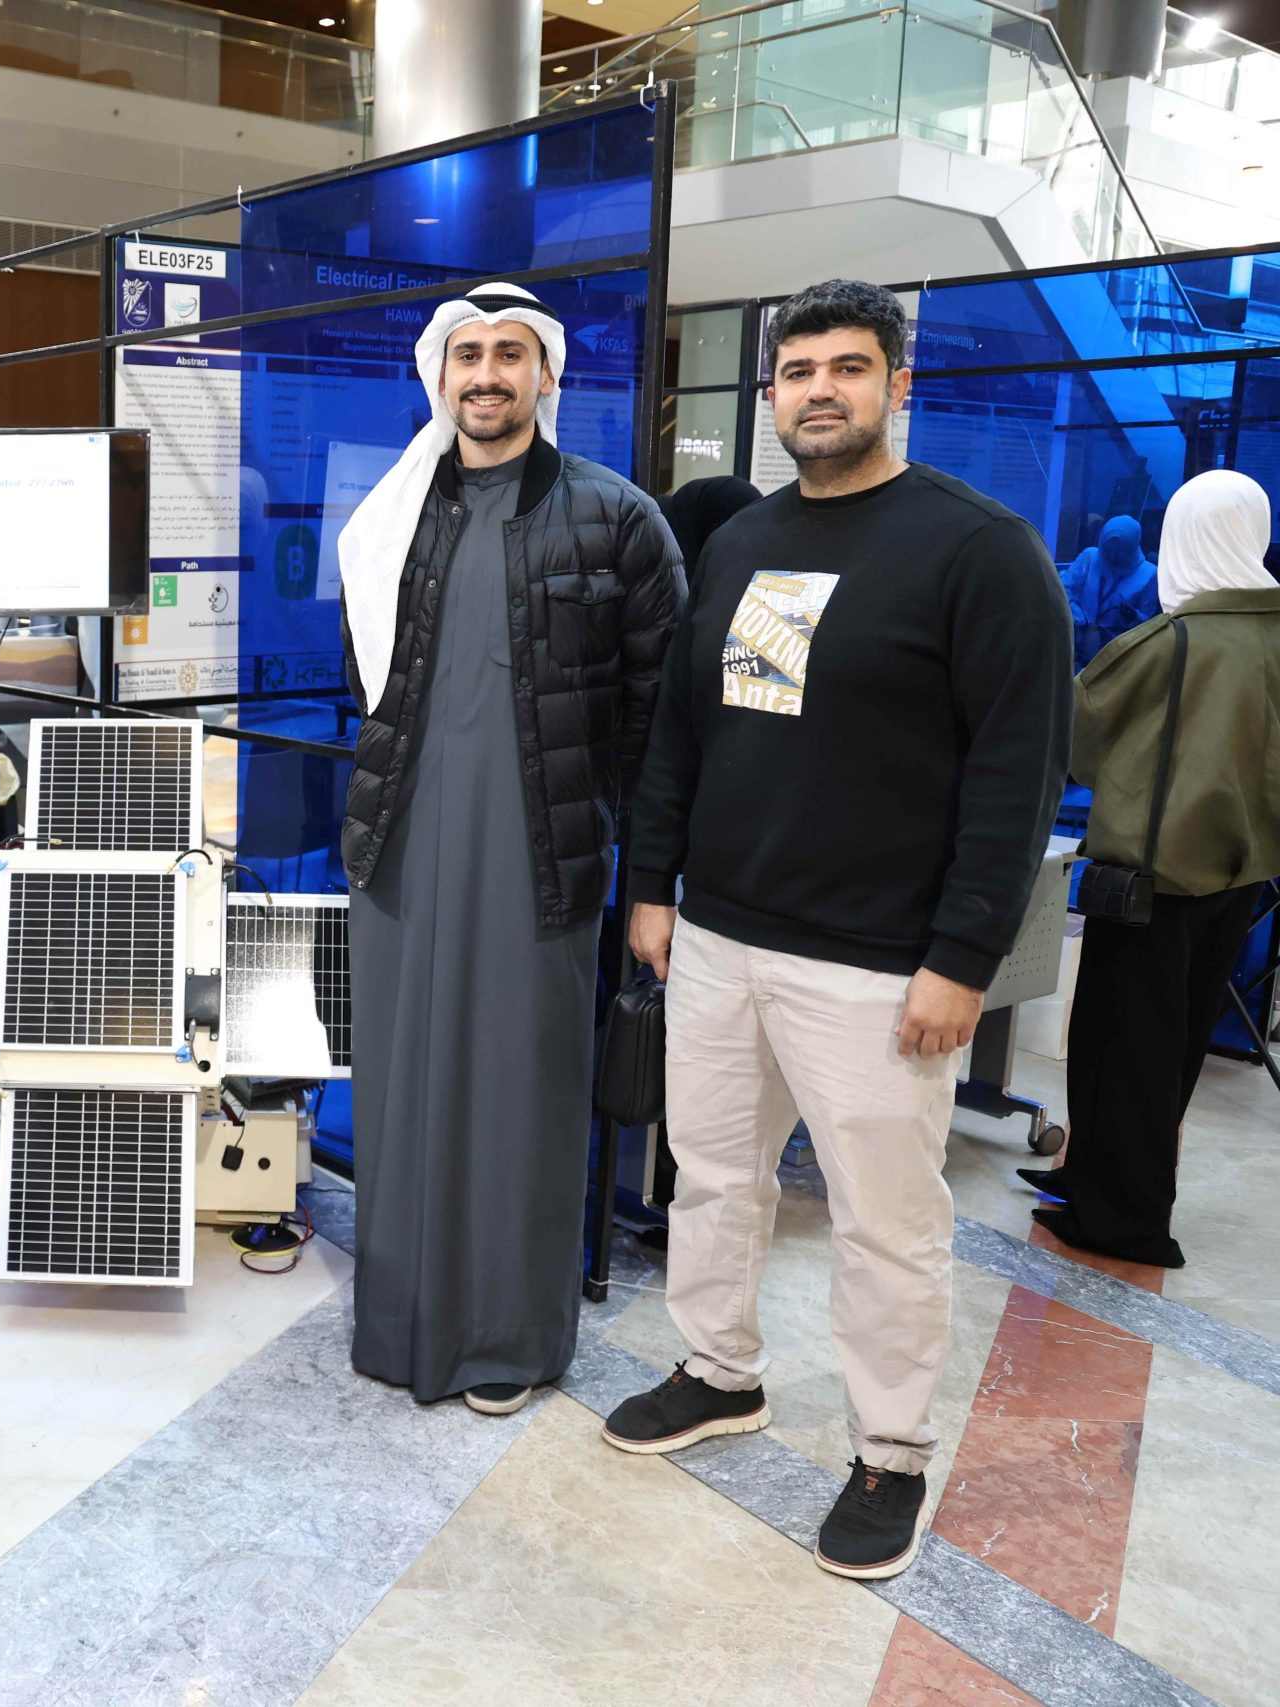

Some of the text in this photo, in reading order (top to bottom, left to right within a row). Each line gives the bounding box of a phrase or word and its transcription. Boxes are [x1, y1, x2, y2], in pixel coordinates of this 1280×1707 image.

[138, 250, 213, 270] ELE03F25
[316, 266, 392, 290] Electrical
[385, 308, 423, 323] HAWA
[600, 338, 628, 353] KFAS
[920, 329, 974, 350] Engineering
[176, 356, 208, 366] Abstract
[181, 561, 198, 570] Path
[722, 673, 802, 716] Anta
